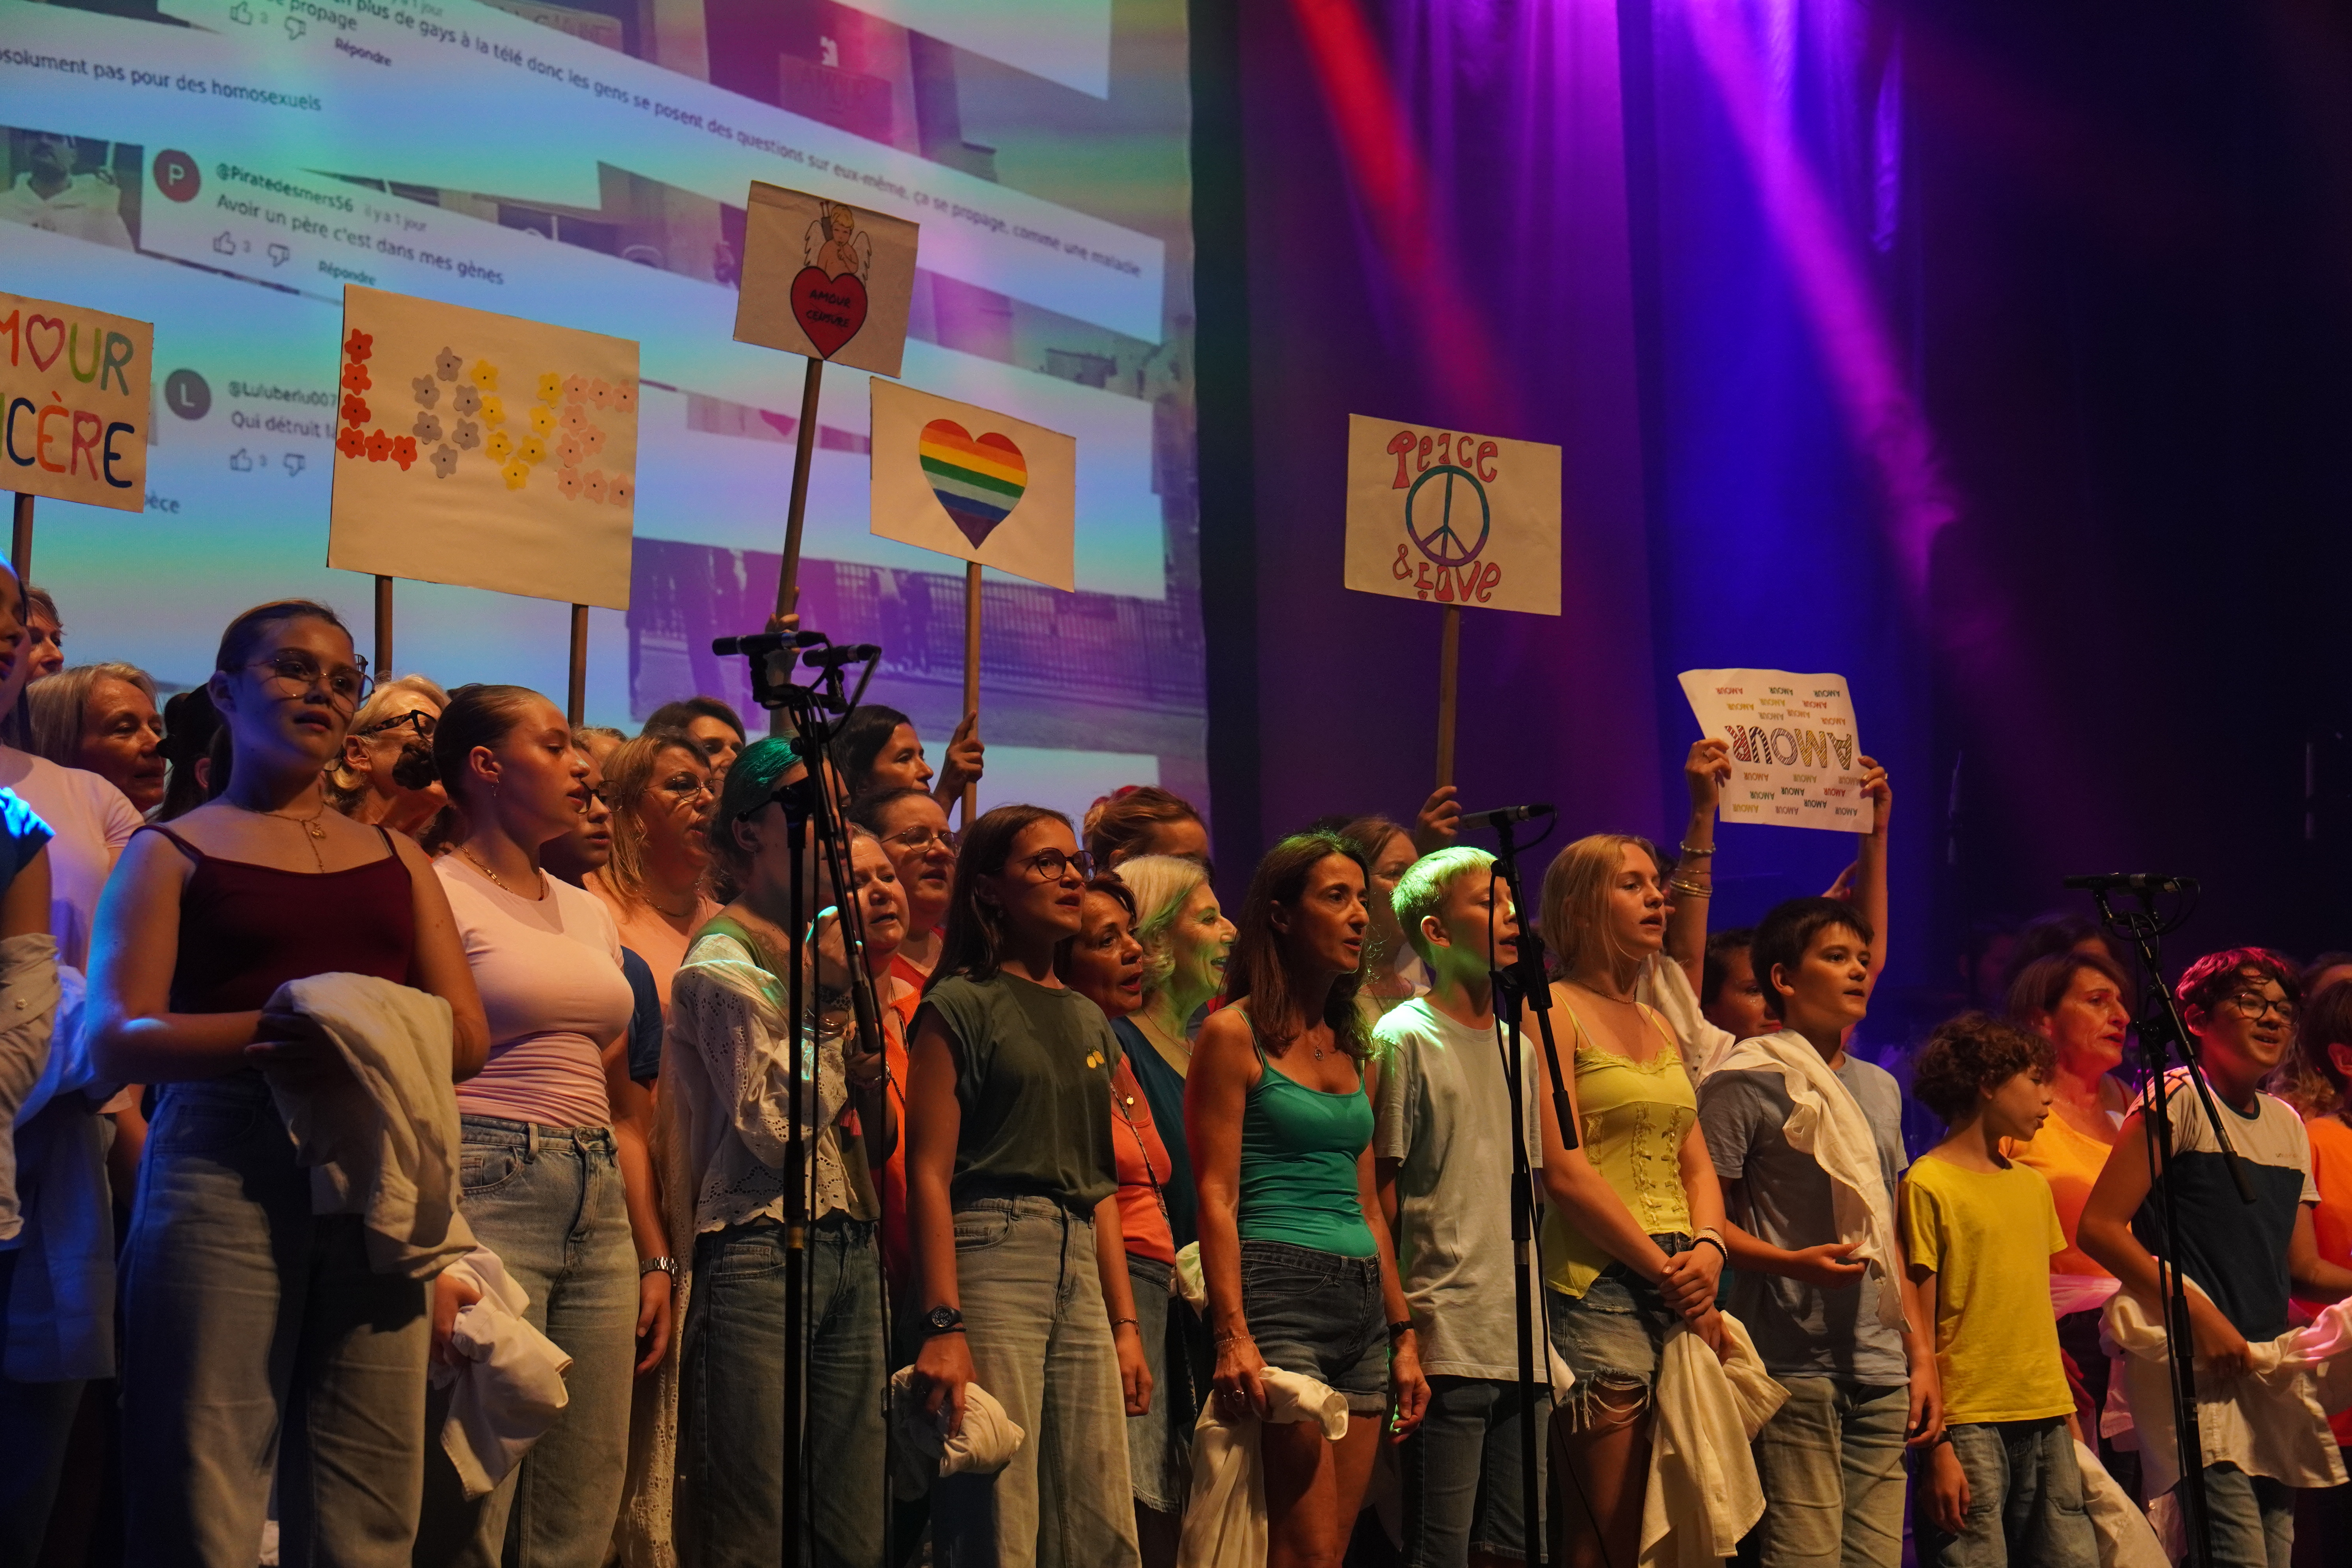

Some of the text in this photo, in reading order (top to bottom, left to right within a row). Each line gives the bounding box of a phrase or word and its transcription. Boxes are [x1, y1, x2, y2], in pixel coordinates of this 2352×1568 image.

[290, 0, 357, 31] propage
[335, 37, 392, 66] Répondre
[93, 63, 125, 80] pas
[131, 69, 170, 86] pour
[176, 74, 206, 94] des
[212, 79, 321, 111] homosexuels
[356, 0, 389, 20] plus
[395, 10, 415, 29] de
[419, 20, 456, 42] gays
[460, 30, 470, 48] à
[475, 35, 489, 54] la
[494, 44, 523, 66] télé
[527, 58, 564, 82] donc
[569, 68, 589, 89] les
[594, 82, 629, 103] gens
[633, 95, 650, 110] se
[655, 102, 704, 130] posent
[707, 119, 733, 139] des
[737, 131, 804, 163] questions
[808, 155, 830, 171] sur
[913, 191, 929, 206] ça
[933, 197, 949, 213] se
[1012, 225, 1060, 251] comme
[1063, 243, 1088, 261] une
[1091, 252, 1142, 278] maladie
[168, 164, 185, 185] P
[216, 163, 354, 212] @Piratedesmers56
[218, 194, 504, 285] Avoir un père c'est dans mes gènes
[319, 260, 377, 285] Répondre
[809, 289, 851, 309] AMOUR
[231, 410, 260, 429] Qui
[265, 416, 321, 438] détruit
[336, 328, 638, 508] LOVE
[0, 390, 135, 488] CÈRE
[1392, 544, 1413, 580] &
[1768, 687, 1793, 696] AMOUR
[1724, 725, 1852, 770] AMOUR
[1744, 772, 1769, 782] AMOUR
[1793, 774, 1817, 783] AMOUR
[1749, 786, 1846, 800] AMOUR AMOUR AMOUR
[1804, 799, 1827, 809] AMOUR
[1732, 804, 1858, 817] AMOUR AMOUR AMOUR
